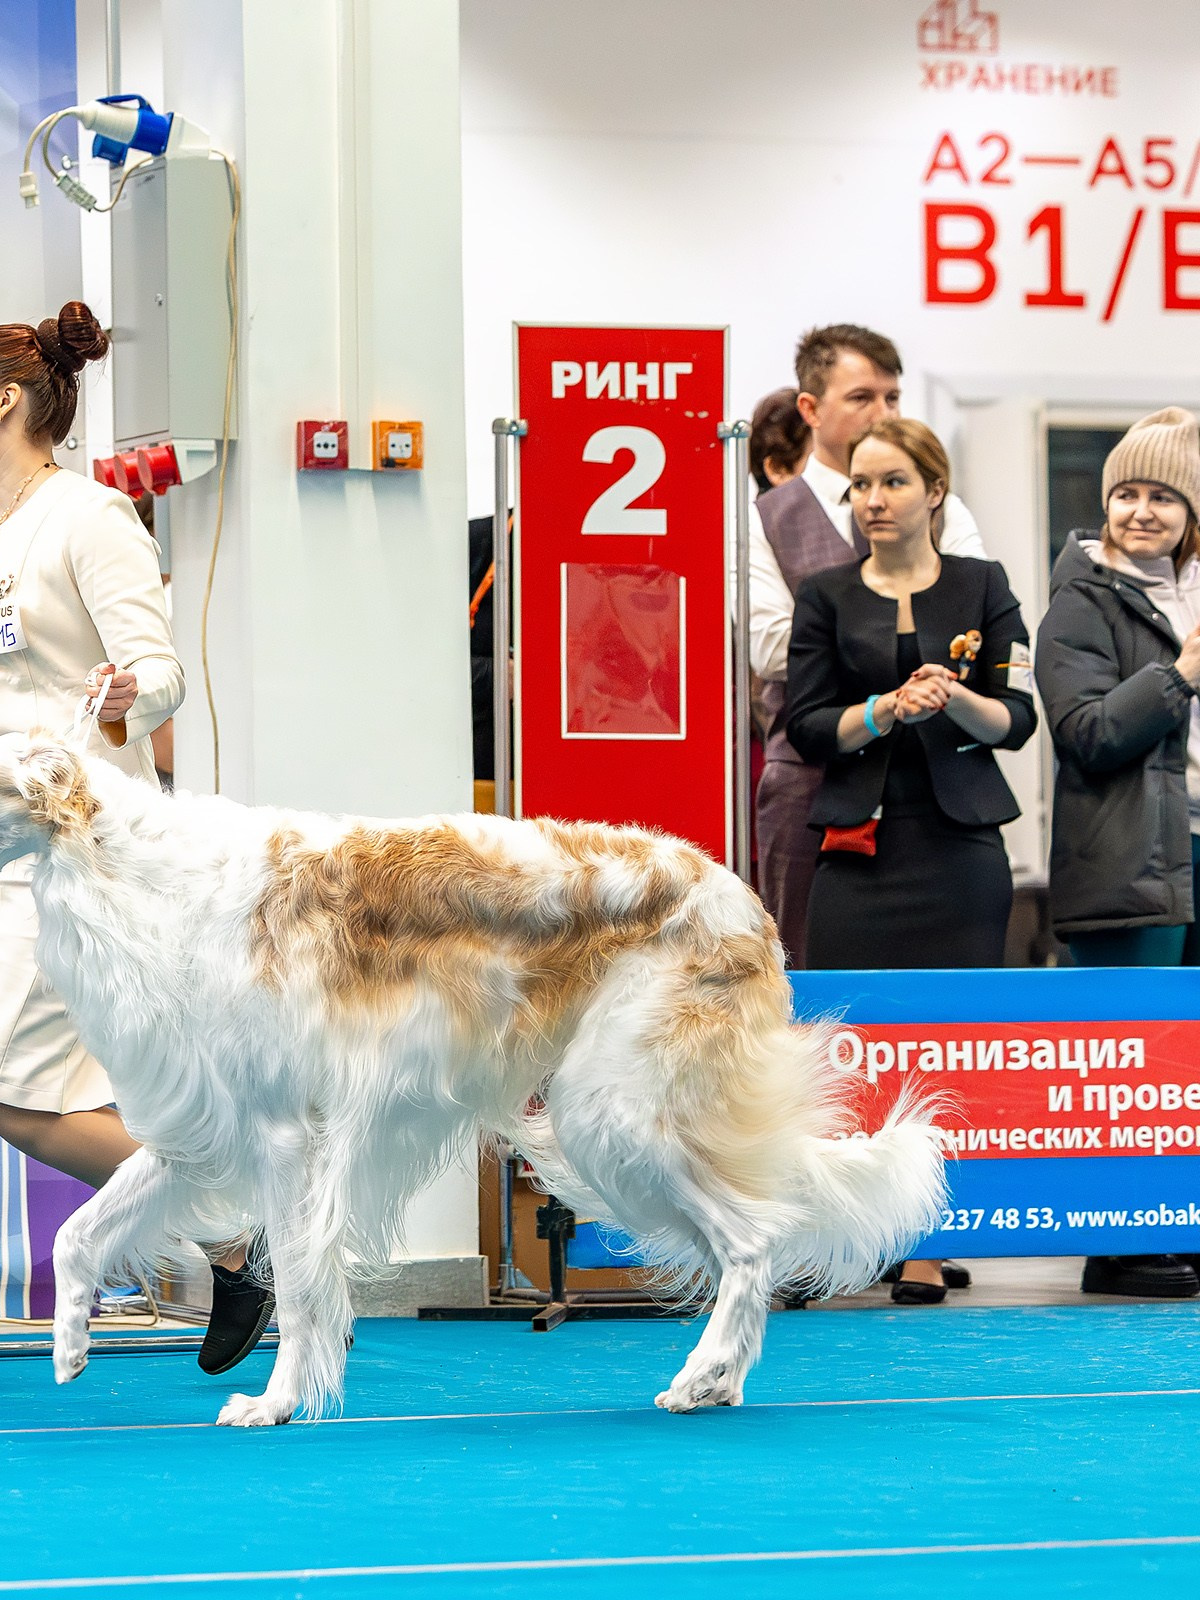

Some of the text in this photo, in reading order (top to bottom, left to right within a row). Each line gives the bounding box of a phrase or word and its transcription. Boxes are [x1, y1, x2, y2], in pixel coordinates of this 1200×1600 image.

[920, 61, 1118, 98] ХРАНЕНИЕ
[551, 360, 694, 400] РИНГ
[580, 425, 668, 536] 2
[828, 1030, 1145, 1083] Организация
[1048, 1085, 1073, 1112] и
[1109, 1125, 1200, 1156] меро
[941, 1208, 985, 1231] 237
[989, 1207, 1020, 1230] 48
[1025, 1206, 1062, 1232] 53,
